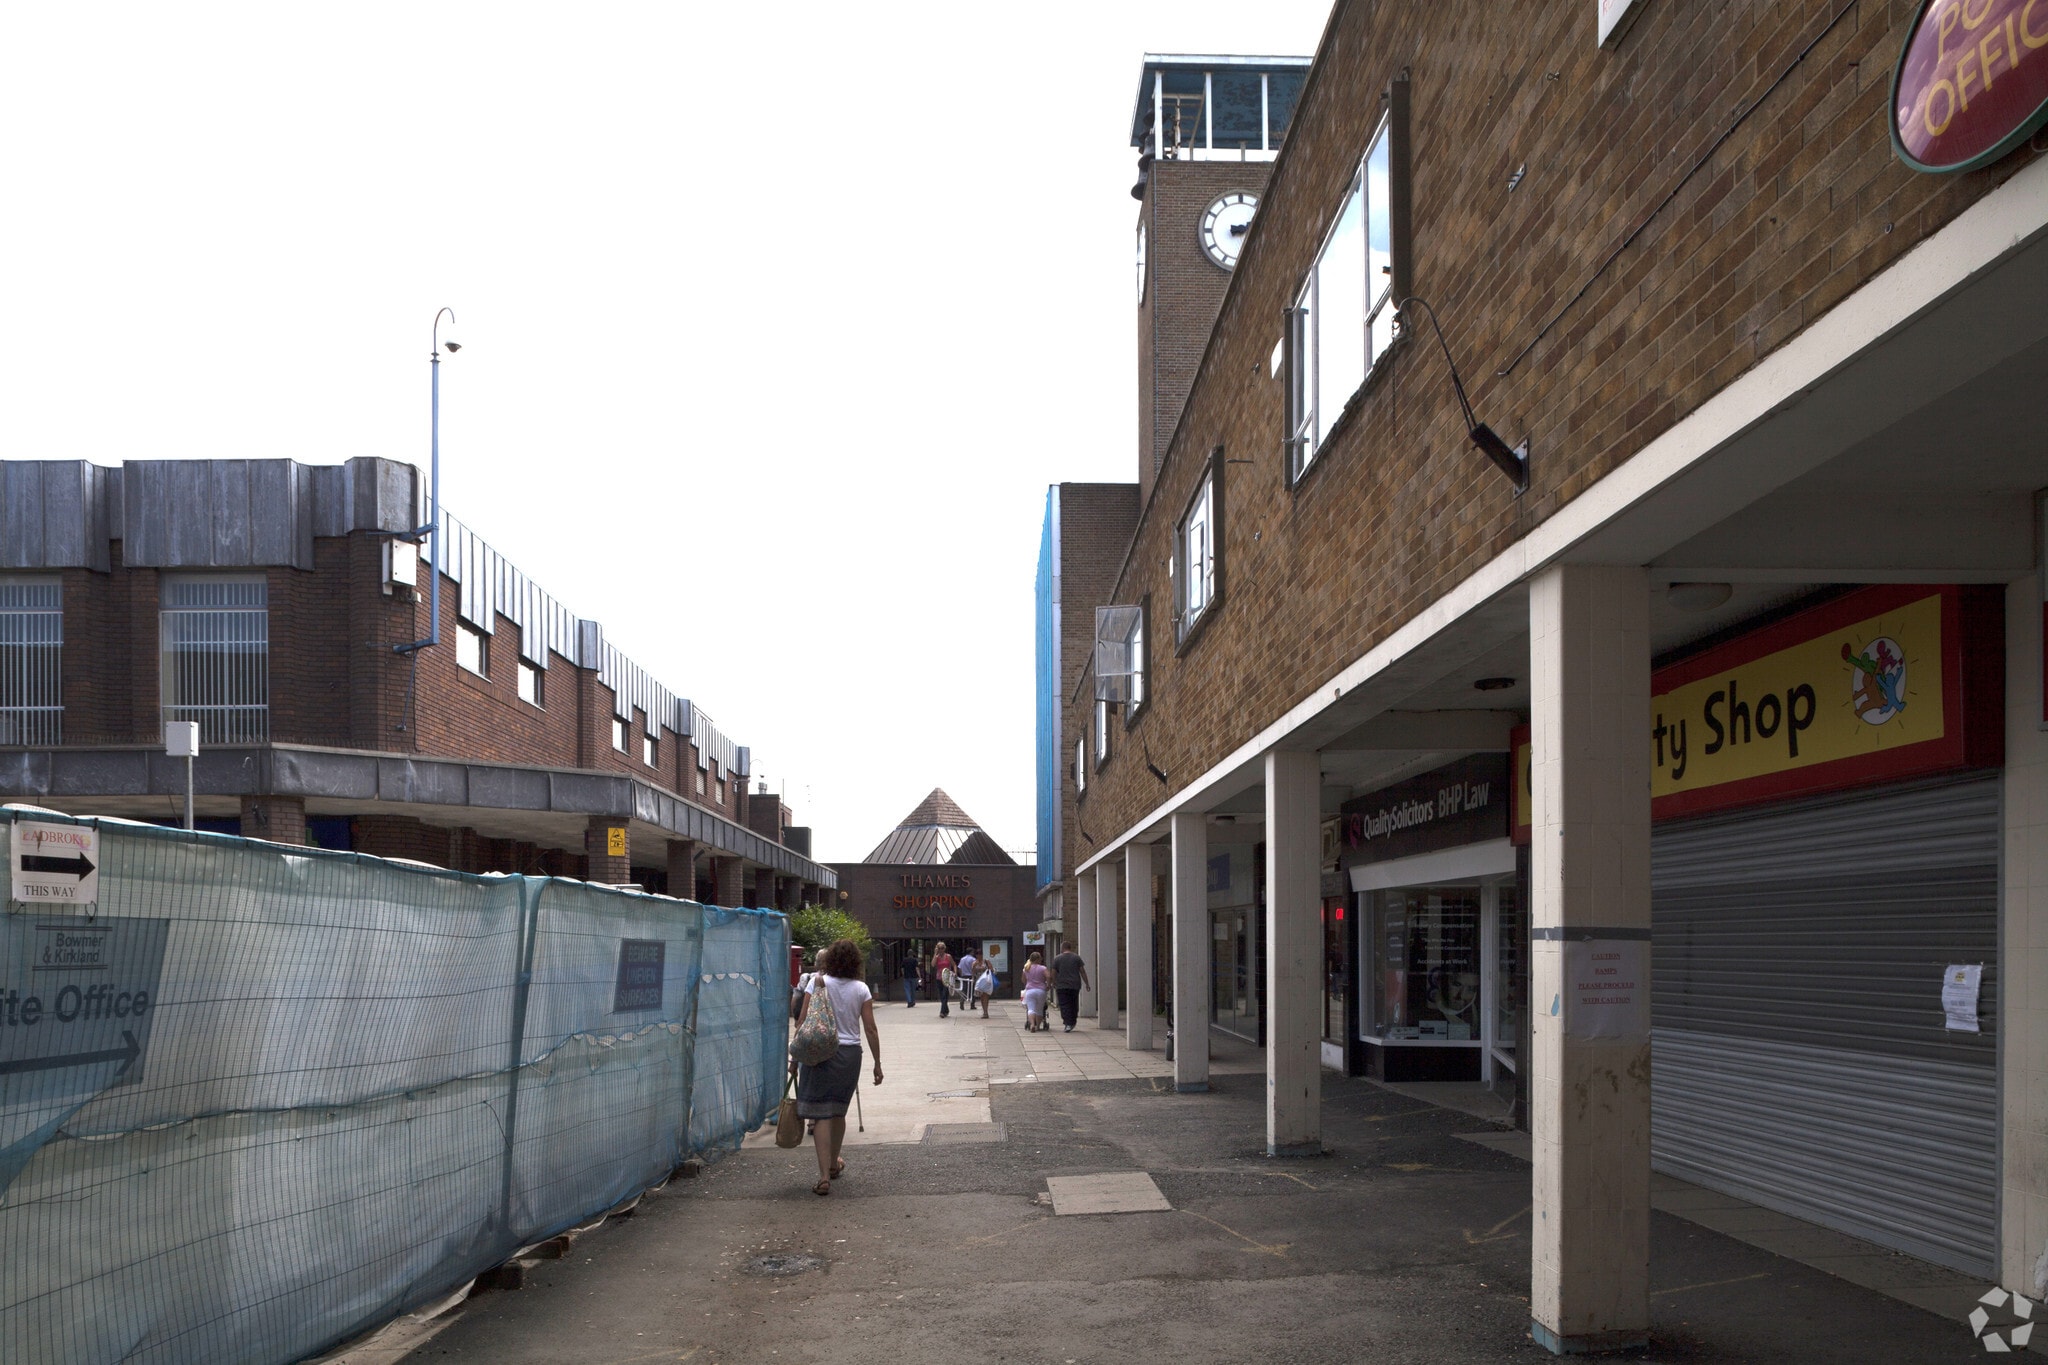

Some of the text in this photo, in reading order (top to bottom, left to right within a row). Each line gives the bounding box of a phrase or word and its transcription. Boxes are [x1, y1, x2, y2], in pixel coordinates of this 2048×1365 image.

[1704, 680, 1817, 759] Shop
[1363, 781, 1490, 840] QualitySolicitors BHP Law
[900, 874, 972, 888] THAMES
[23, 885, 76, 898] THIS WAY
[892, 895, 976, 910] SHOPPING
[902, 915, 968, 930] CENTRE
[56, 933, 104, 948] Bowmer
[42, 945, 100, 964] & Kirkland
[55, 983, 149, 1023] Office
